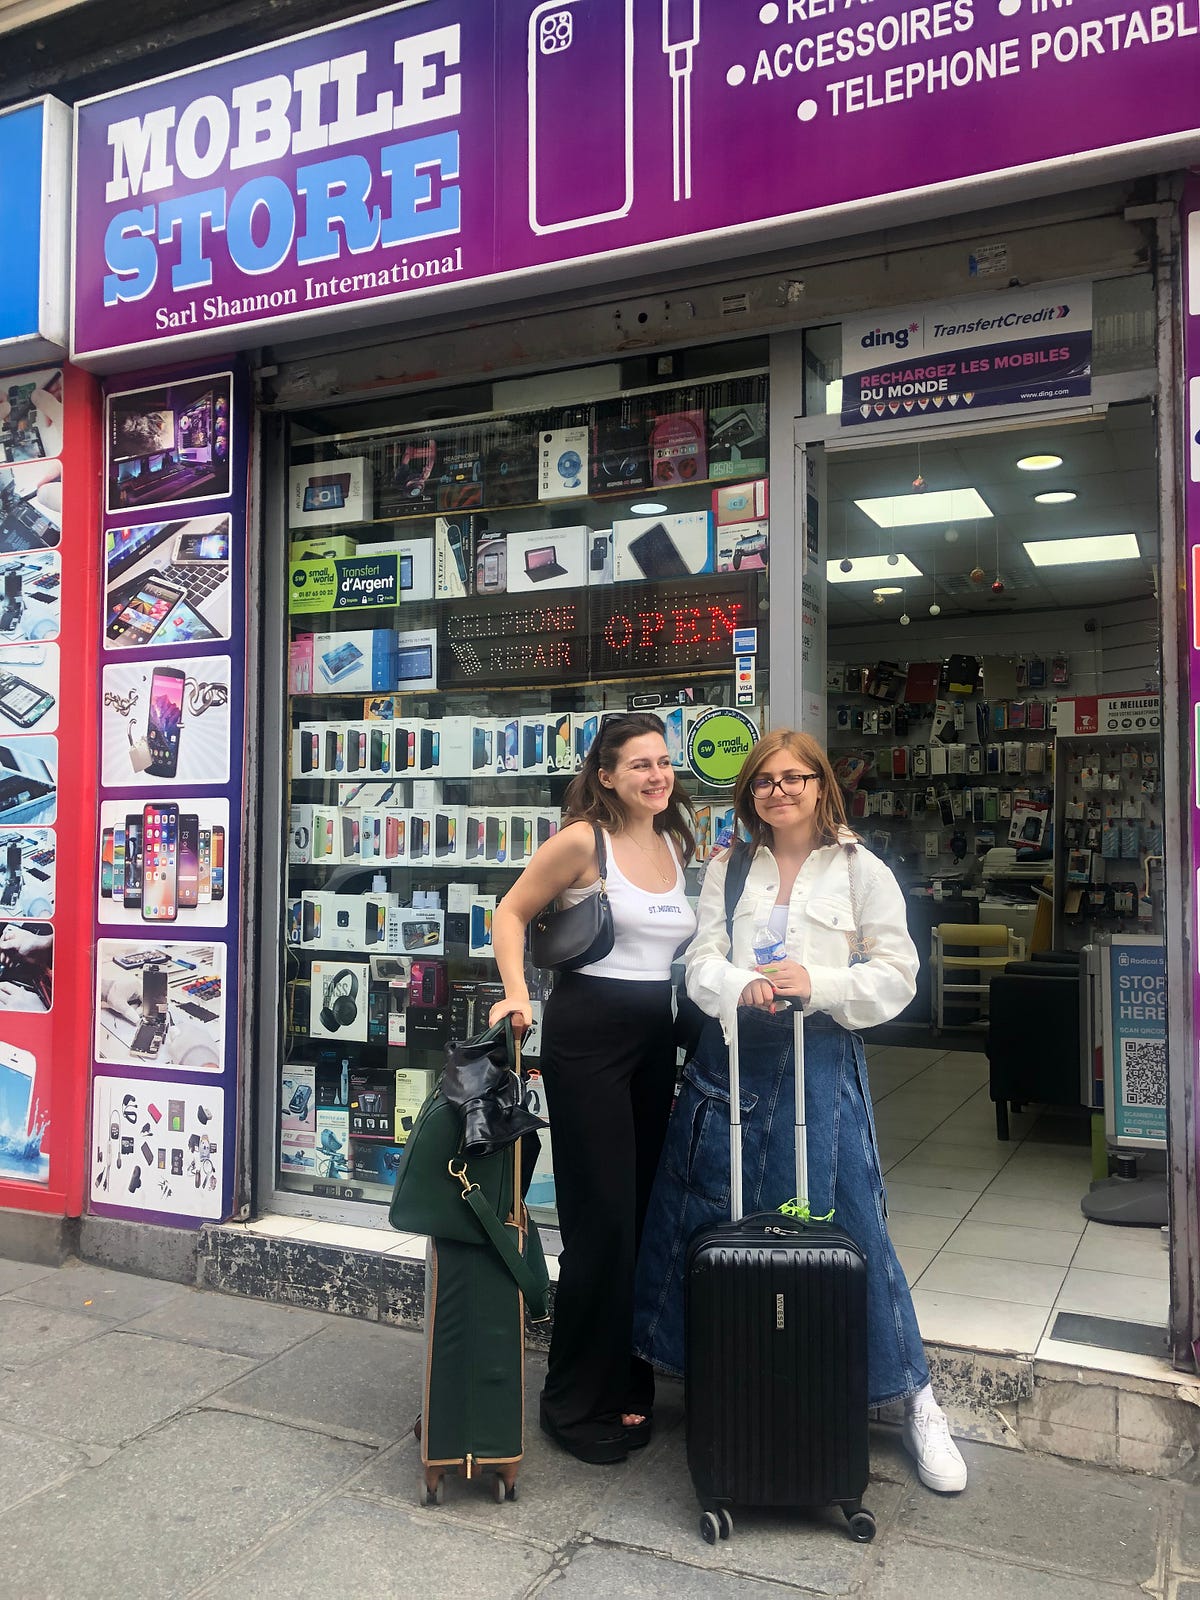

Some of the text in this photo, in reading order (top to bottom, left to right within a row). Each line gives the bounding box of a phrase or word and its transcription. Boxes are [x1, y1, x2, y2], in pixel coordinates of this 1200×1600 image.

[752, 1, 975, 84] ACCESSOIRES
[826, 37, 1020, 117] TELEPHONE
[105, 23, 461, 203] MOBILE
[103, 130, 461, 306] STORE
[155, 248, 463, 330] Sarl Shannon International
[933, 307, 1055, 338] TransfertCredit
[861, 328, 908, 348] ding
[861, 347, 1070, 388] RECHARGEZ LES MOBILES
[861, 378, 948, 401] DU MONDE
[1020, 388, 1069, 400] www.ding.com
[308, 568, 329, 578] small
[313, 574, 334, 582] world
[342, 565, 380, 578] Transfert
[342, 575, 394, 594] d'Argent
[604, 604, 742, 648] OPEN
[490, 642, 571, 671] REPAIR
[1109, 699, 1160, 710] LE MEILLEUR
[718, 736, 740, 747] small
[724, 742, 748, 753] world
[1120, 1006, 1166, 1020] HERE
